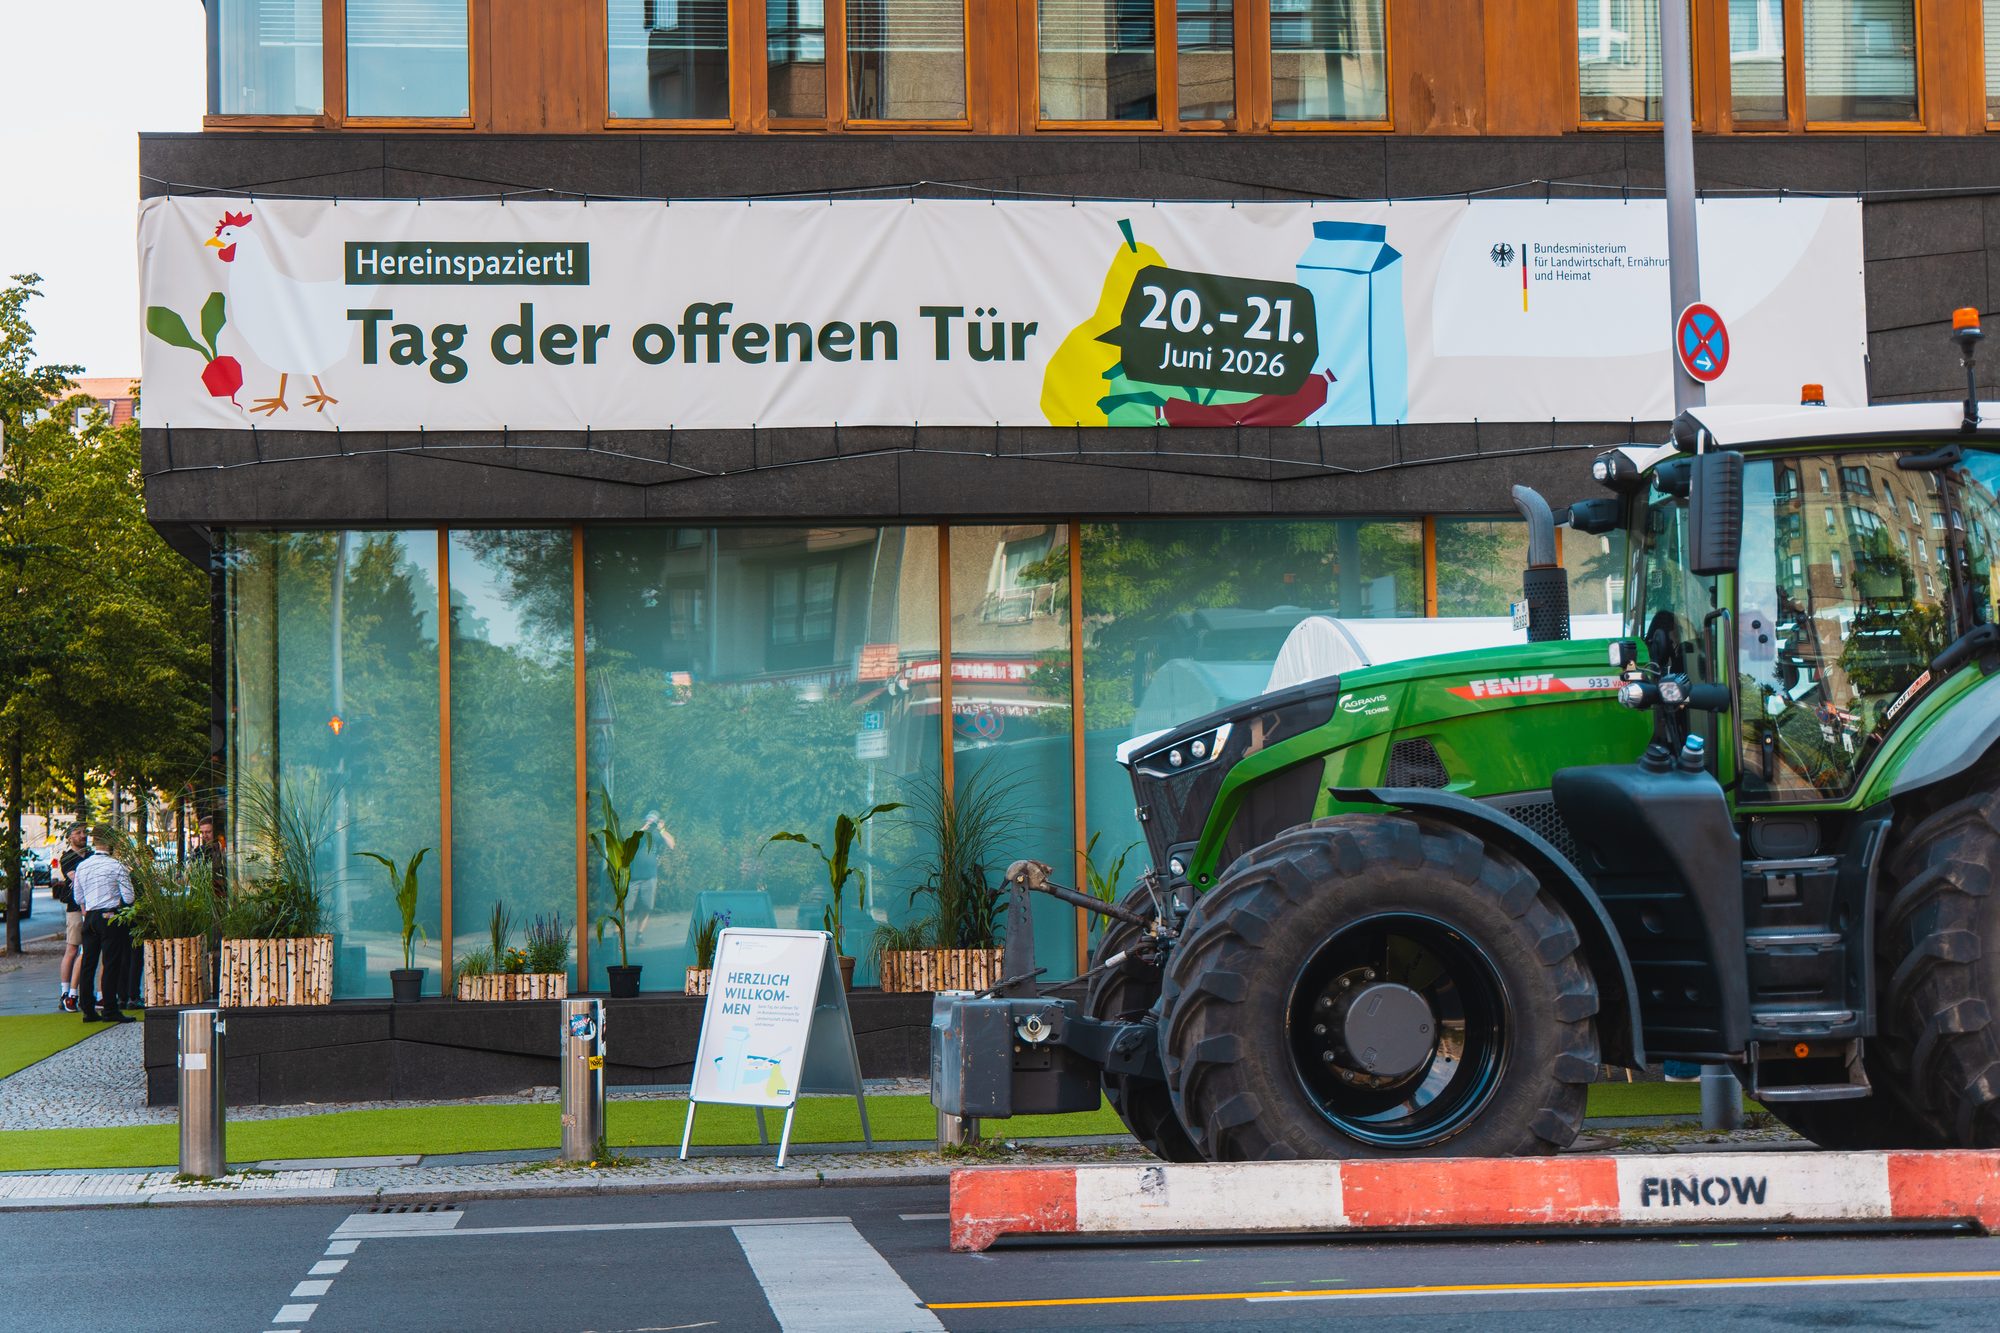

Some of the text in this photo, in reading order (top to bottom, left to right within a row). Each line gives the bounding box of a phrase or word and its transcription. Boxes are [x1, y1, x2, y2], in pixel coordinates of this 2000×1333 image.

[1534, 243, 1627, 254] Bundesministerium
[356, 248, 574, 282] Hereinspaziert!
[1534, 256, 1671, 269] für Landwirtschaft, Ernährun
[1534, 270, 1591, 281] und Heimat
[346, 302, 1039, 384] Tag der offenen Tür
[1158, 342, 1286, 378] Juni 2026
[1469, 673, 1554, 697] FENDT
[1588, 678, 1610, 689] 933
[1344, 694, 1388, 709] AGRAVIS
[727, 971, 790, 986] HERZLICH
[724, 987, 790, 1002] WILLKOM-
[721, 1002, 751, 1016] MEN
[1641, 1176, 1767, 1208] FINOW
